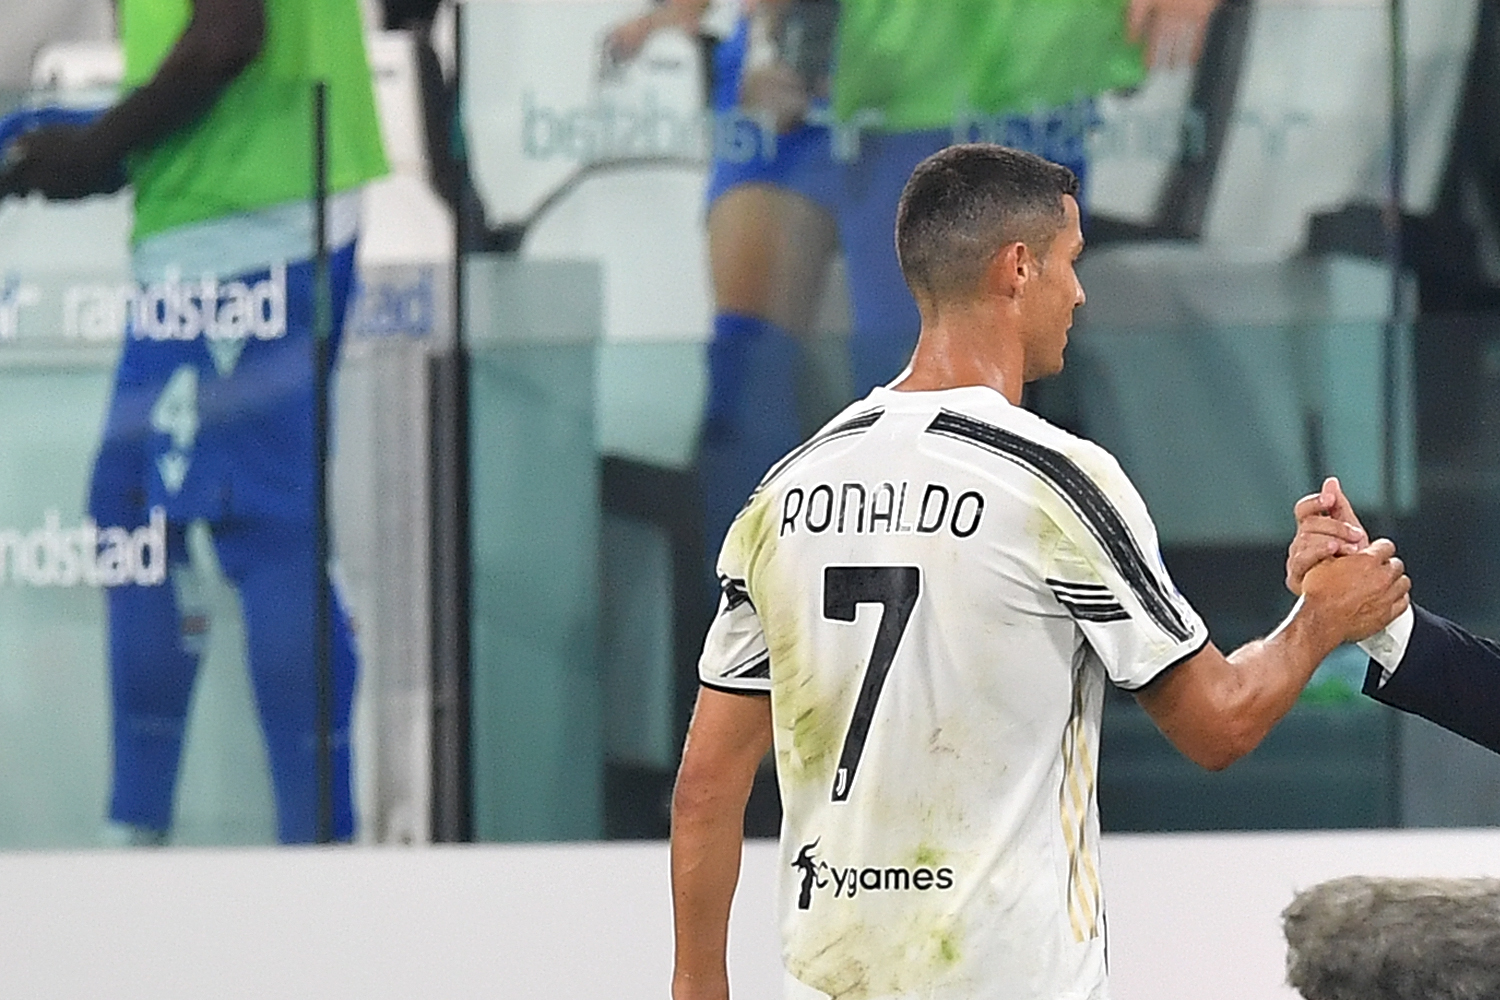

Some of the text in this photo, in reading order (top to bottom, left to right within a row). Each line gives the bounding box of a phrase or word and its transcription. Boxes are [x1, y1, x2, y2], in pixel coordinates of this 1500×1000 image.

[63, 258, 287, 341] randstad
[151, 364, 200, 450] 4
[779, 481, 985, 538] RONALDO
[823, 566, 920, 802] 7
[816, 860, 954, 898] Cygames
